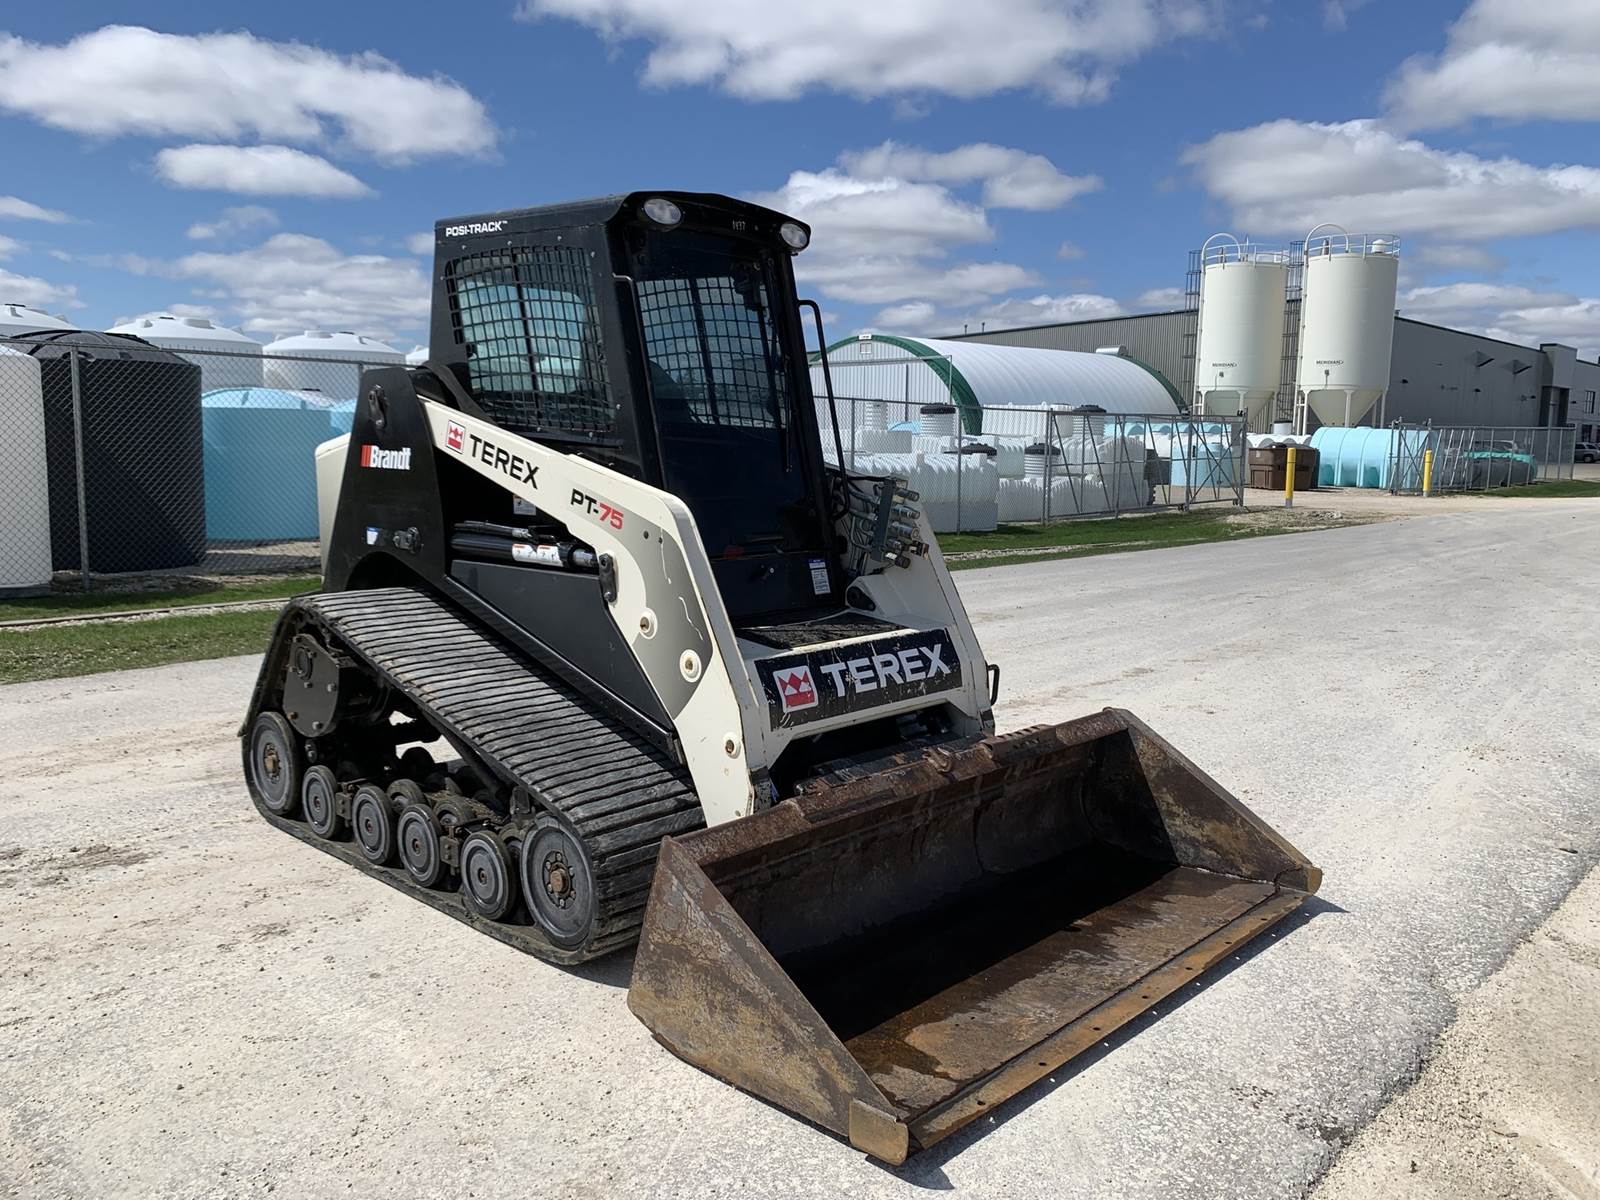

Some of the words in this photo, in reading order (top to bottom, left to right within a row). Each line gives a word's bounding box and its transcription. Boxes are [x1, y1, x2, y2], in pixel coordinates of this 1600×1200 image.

[370, 445, 411, 470] Brandt
[469, 434, 539, 489] TEREX
[570, 488, 624, 530] PT-75
[820, 643, 951, 698] TEREX
